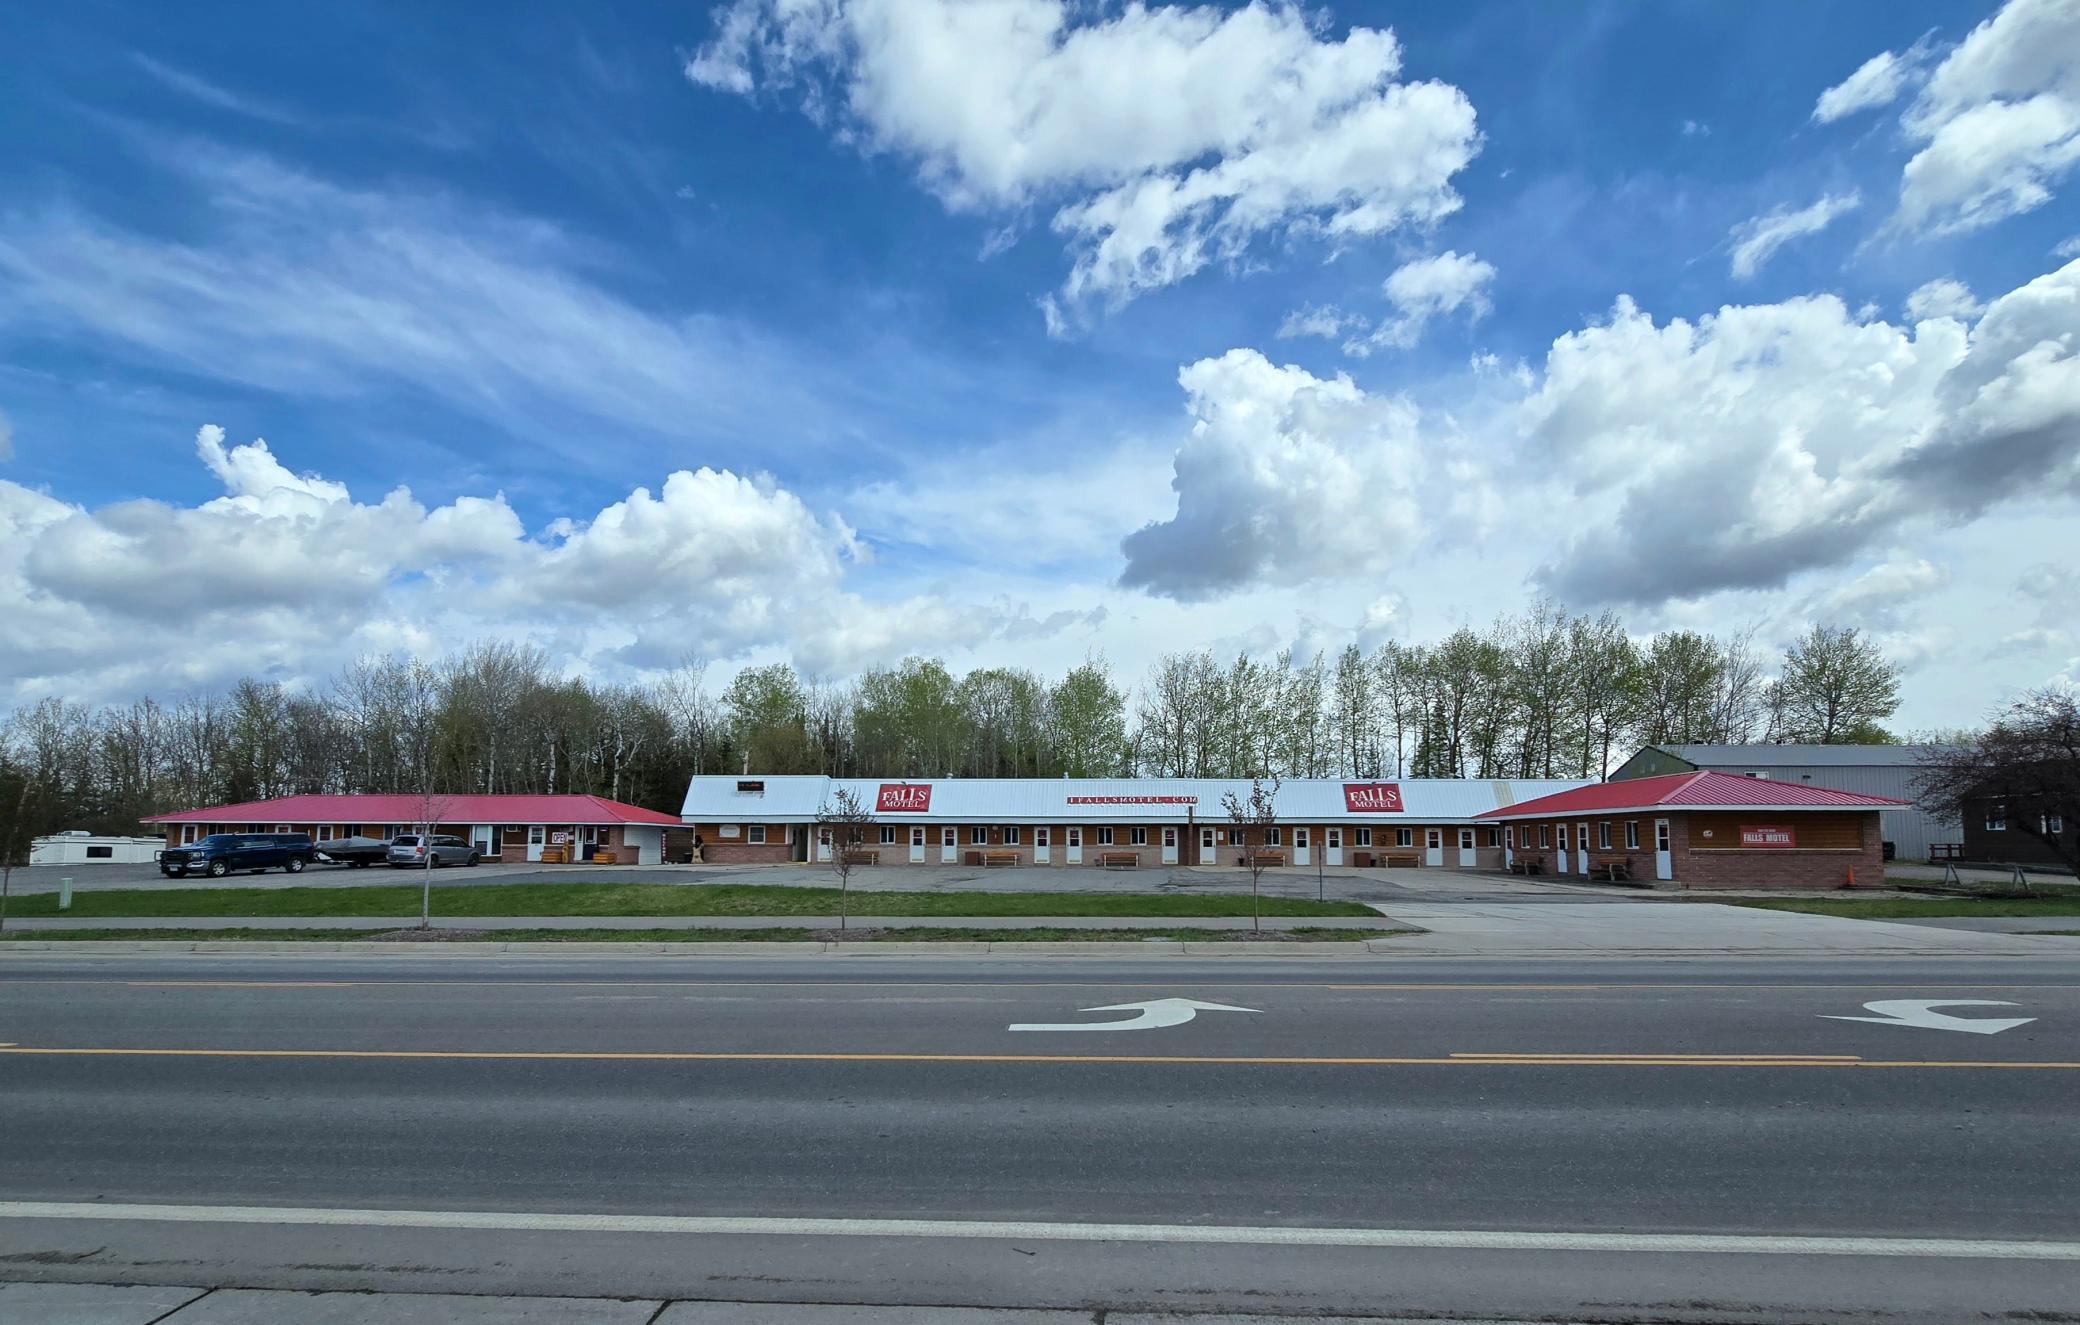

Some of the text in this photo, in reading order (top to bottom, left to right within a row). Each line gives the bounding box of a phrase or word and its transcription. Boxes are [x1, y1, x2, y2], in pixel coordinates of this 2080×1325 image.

[882, 787, 927, 801] FALLS
[1349, 787, 1397, 801] FALLS
[1354, 800, 1395, 808] MOTEL
[1743, 833, 1790, 842] FALLS MOTEL
